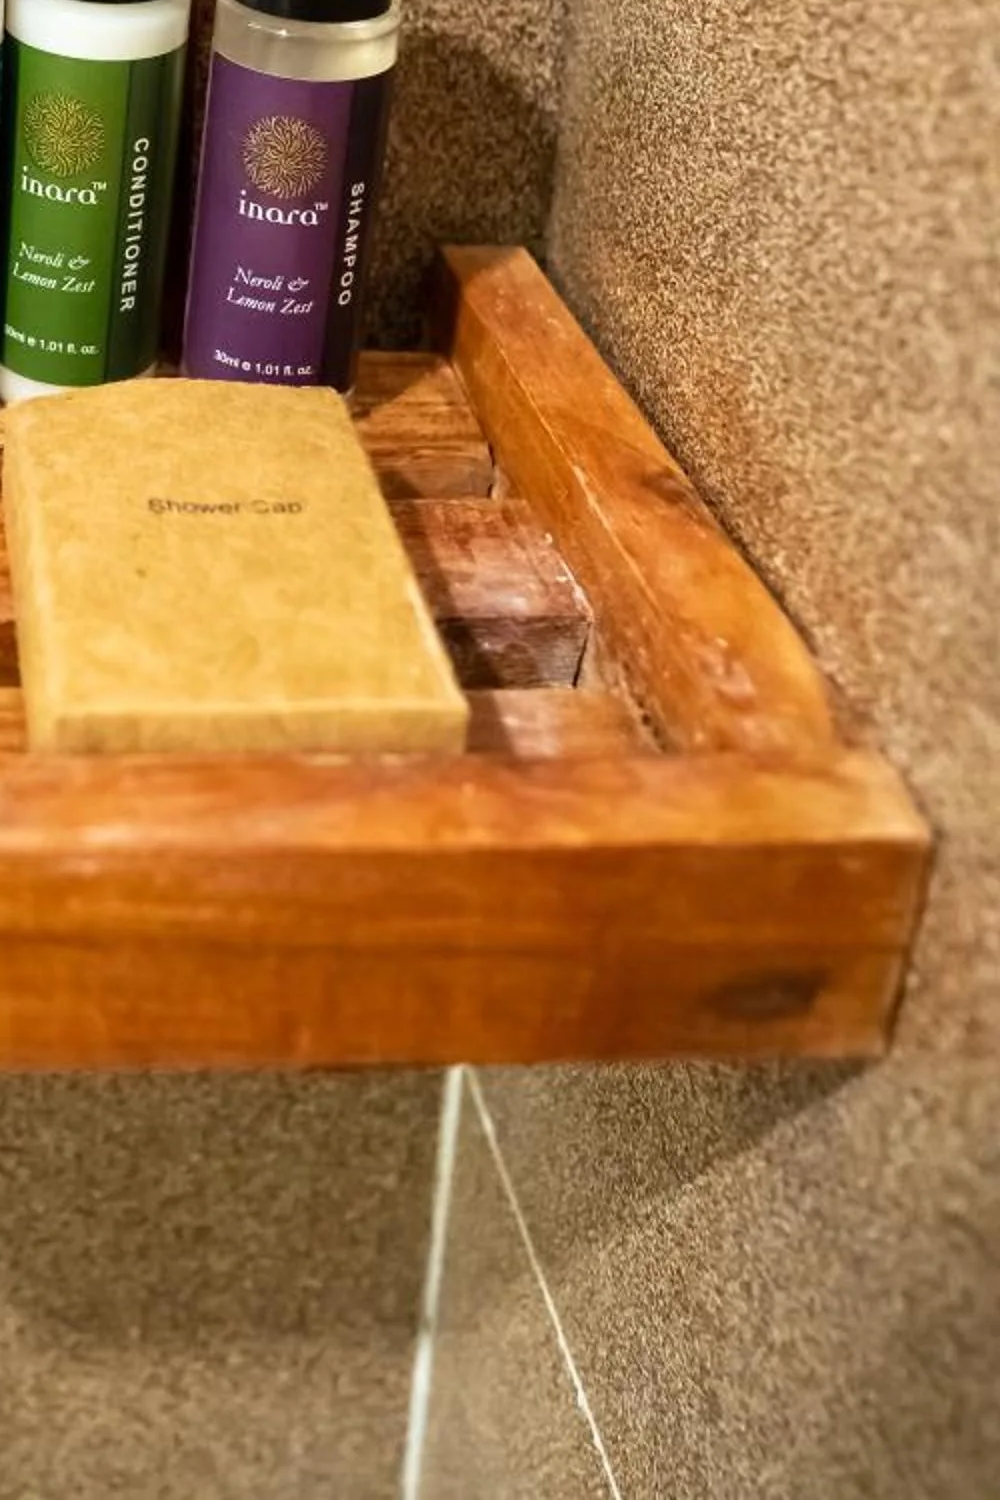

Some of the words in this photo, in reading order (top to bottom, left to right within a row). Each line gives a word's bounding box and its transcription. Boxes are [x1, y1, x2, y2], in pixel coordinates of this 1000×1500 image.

[119, 137, 150, 312] CONDITIONER
[19, 242, 63, 269] Neroli
[68, 255, 90, 270] &
[337, 182, 365, 307] SHAMPOO
[12, 261, 57, 290] Lemon
[60, 275, 96, 293] Zest
[233, 265, 283, 292] Neroli
[288, 276, 310, 292] &
[226, 286, 275, 313] Lemon
[280, 297, 314, 314] Zest
[255, 363, 279, 375] 1.01
[148, 498, 240, 516] Shower
[251, 499, 302, 517] Cap
